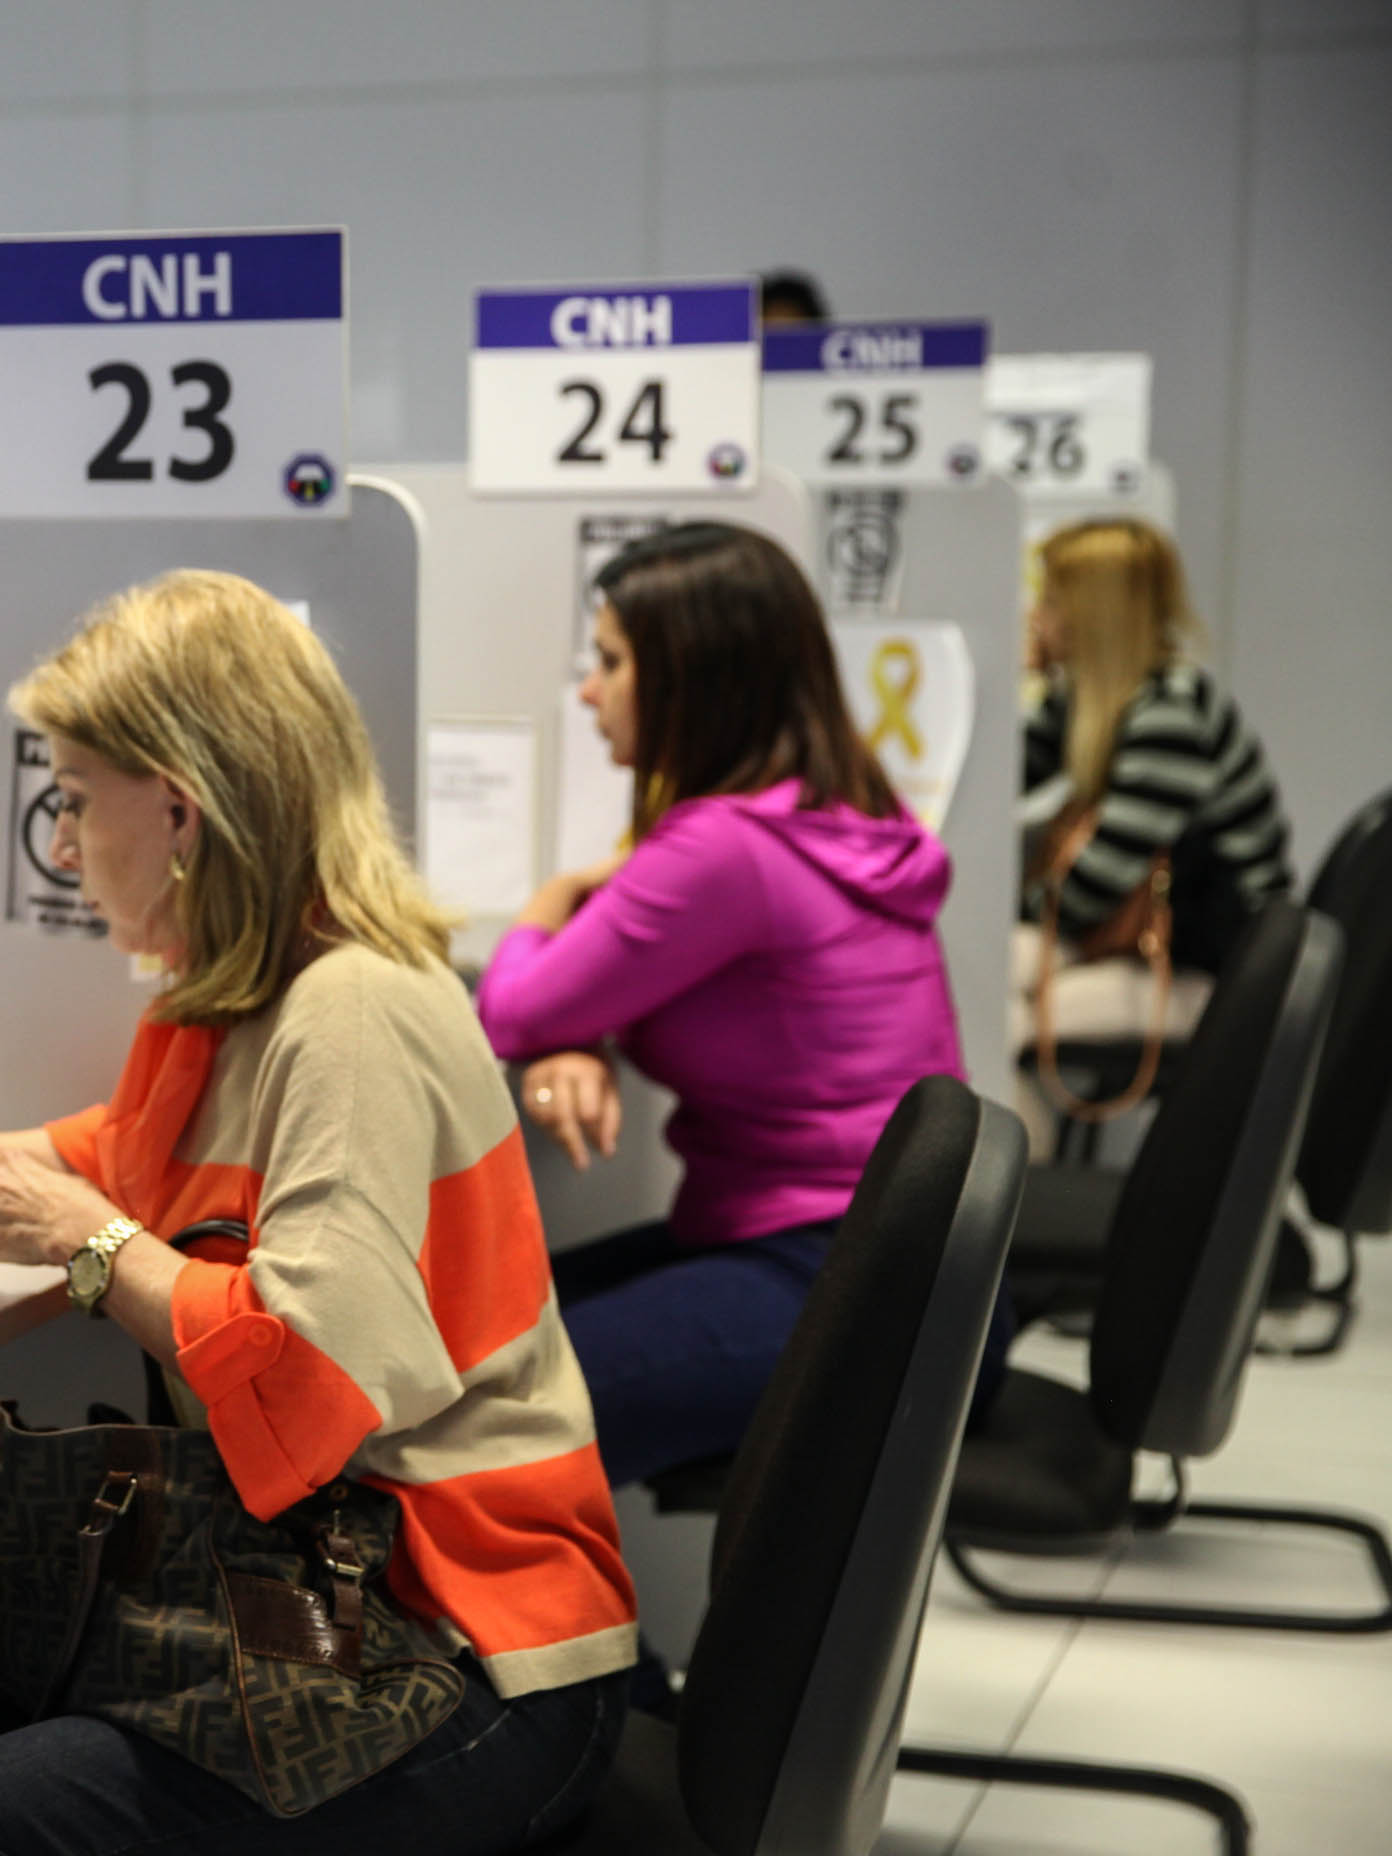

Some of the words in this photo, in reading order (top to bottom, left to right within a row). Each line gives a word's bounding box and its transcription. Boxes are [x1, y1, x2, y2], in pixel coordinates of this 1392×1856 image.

[82, 251, 233, 321] CNH
[550, 295, 673, 348] CNH
[821, 328, 924, 371] CNH
[86, 359, 236, 483] 23
[557, 379, 673, 465] 24
[826, 394, 920, 466] 25
[1008, 413, 1086, 475] 26
